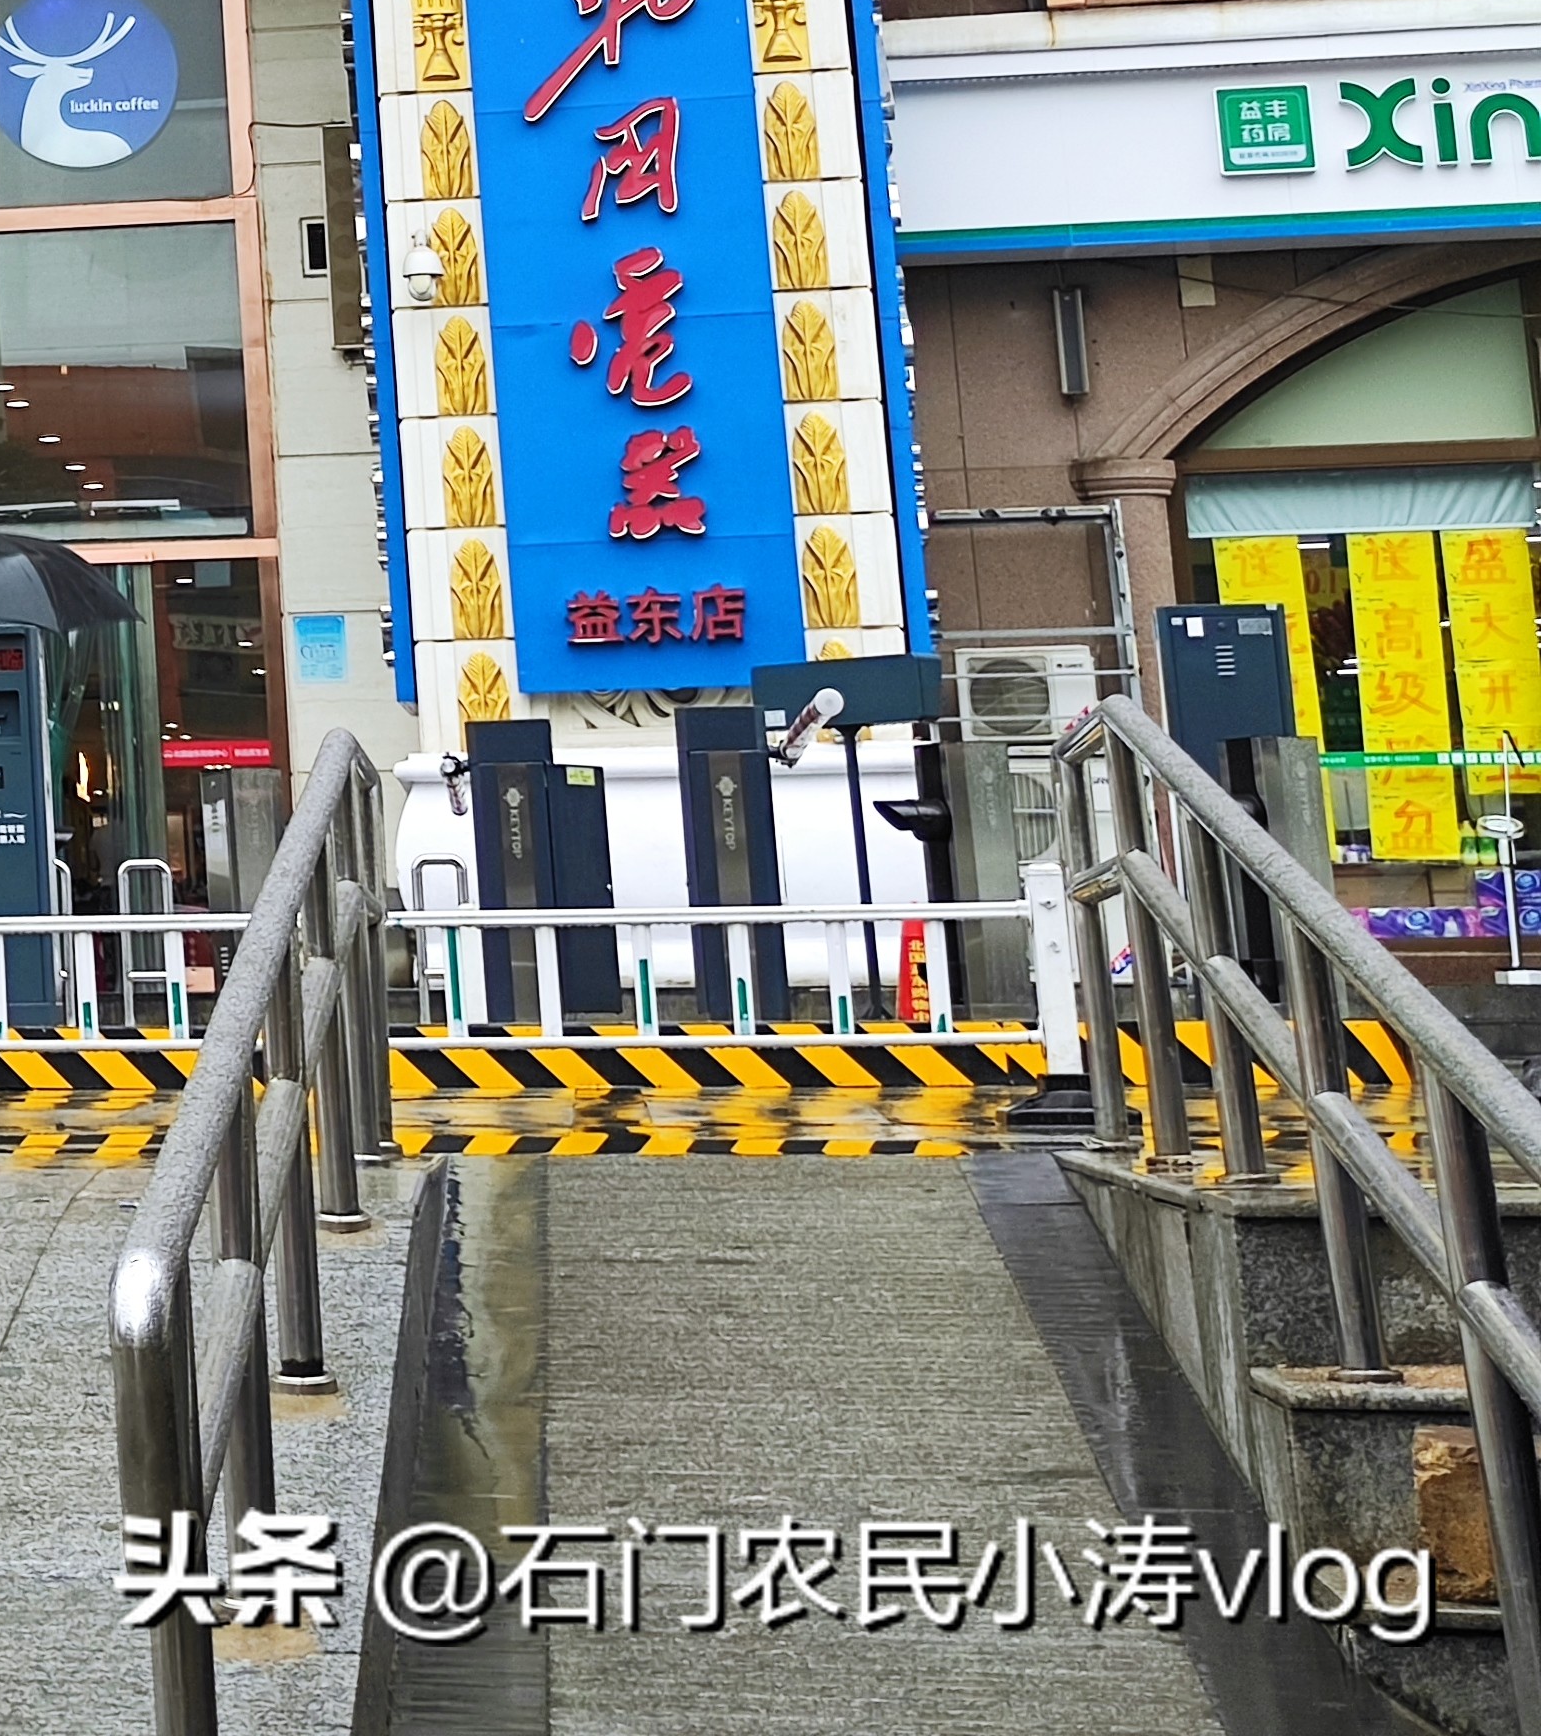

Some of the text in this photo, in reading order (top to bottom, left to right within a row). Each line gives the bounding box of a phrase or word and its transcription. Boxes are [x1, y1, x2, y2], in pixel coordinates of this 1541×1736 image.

[69, 96, 160, 114] luckin coffee
[1239, 98, 1289, 121] 益丰
[1240, 123, 1292, 144] 药房
[565, 583, 746, 646] 益东店
[722, 798, 736, 851] KEYTOP
